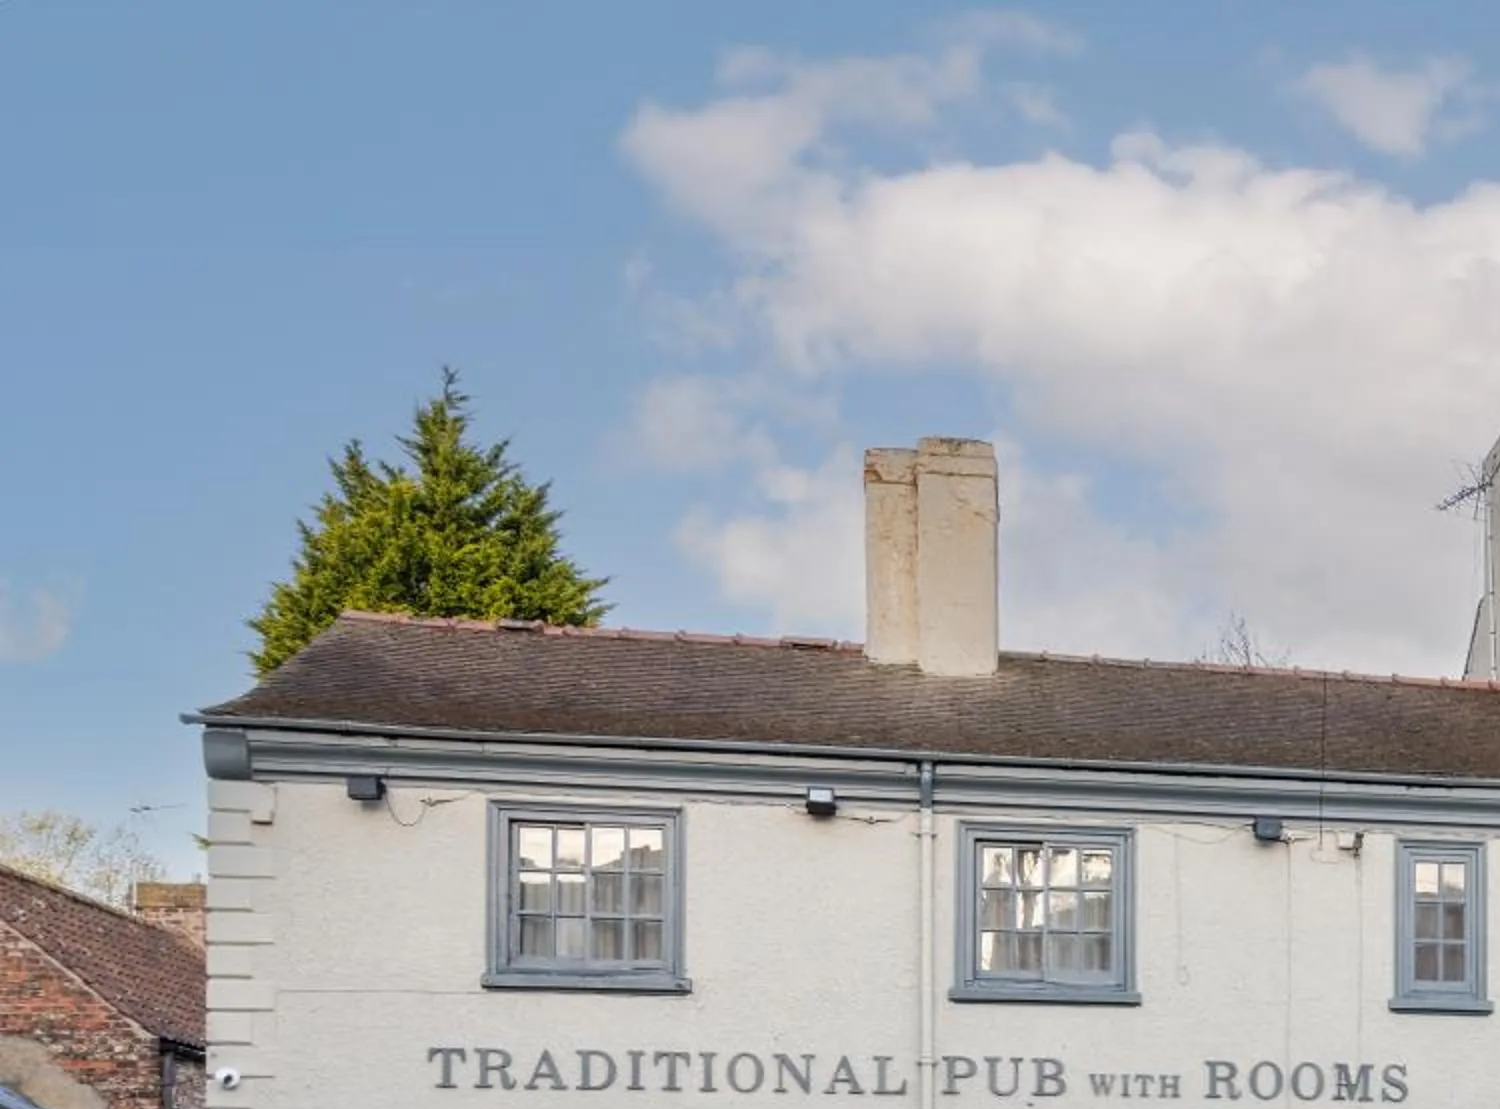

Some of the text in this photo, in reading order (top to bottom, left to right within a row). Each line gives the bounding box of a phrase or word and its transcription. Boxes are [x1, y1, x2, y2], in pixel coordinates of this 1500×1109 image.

[427, 1047, 1409, 1103] TRADITIONAL PUB WITH ROOMS
